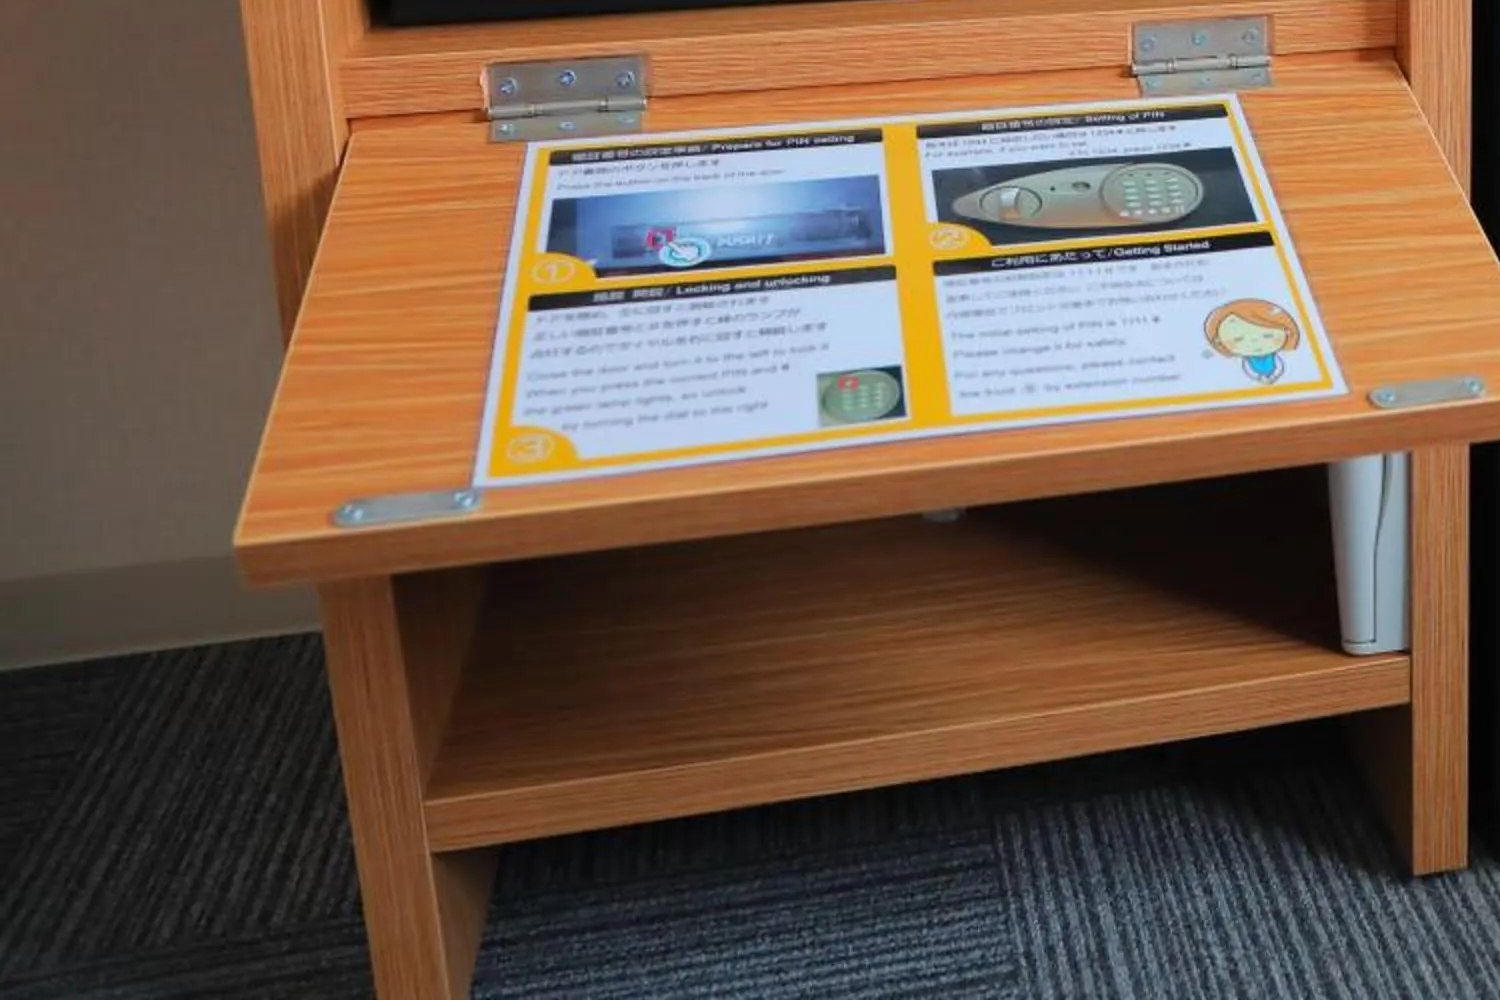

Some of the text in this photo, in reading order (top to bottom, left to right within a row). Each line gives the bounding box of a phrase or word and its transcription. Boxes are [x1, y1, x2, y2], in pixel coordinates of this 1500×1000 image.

[1142, 110, 1166, 120] PIN
[1162, 240, 1210, 253] Started
[676, 281, 731, 295] Locking
[733, 279, 761, 291] and
[764, 274, 831, 288] unlocking
